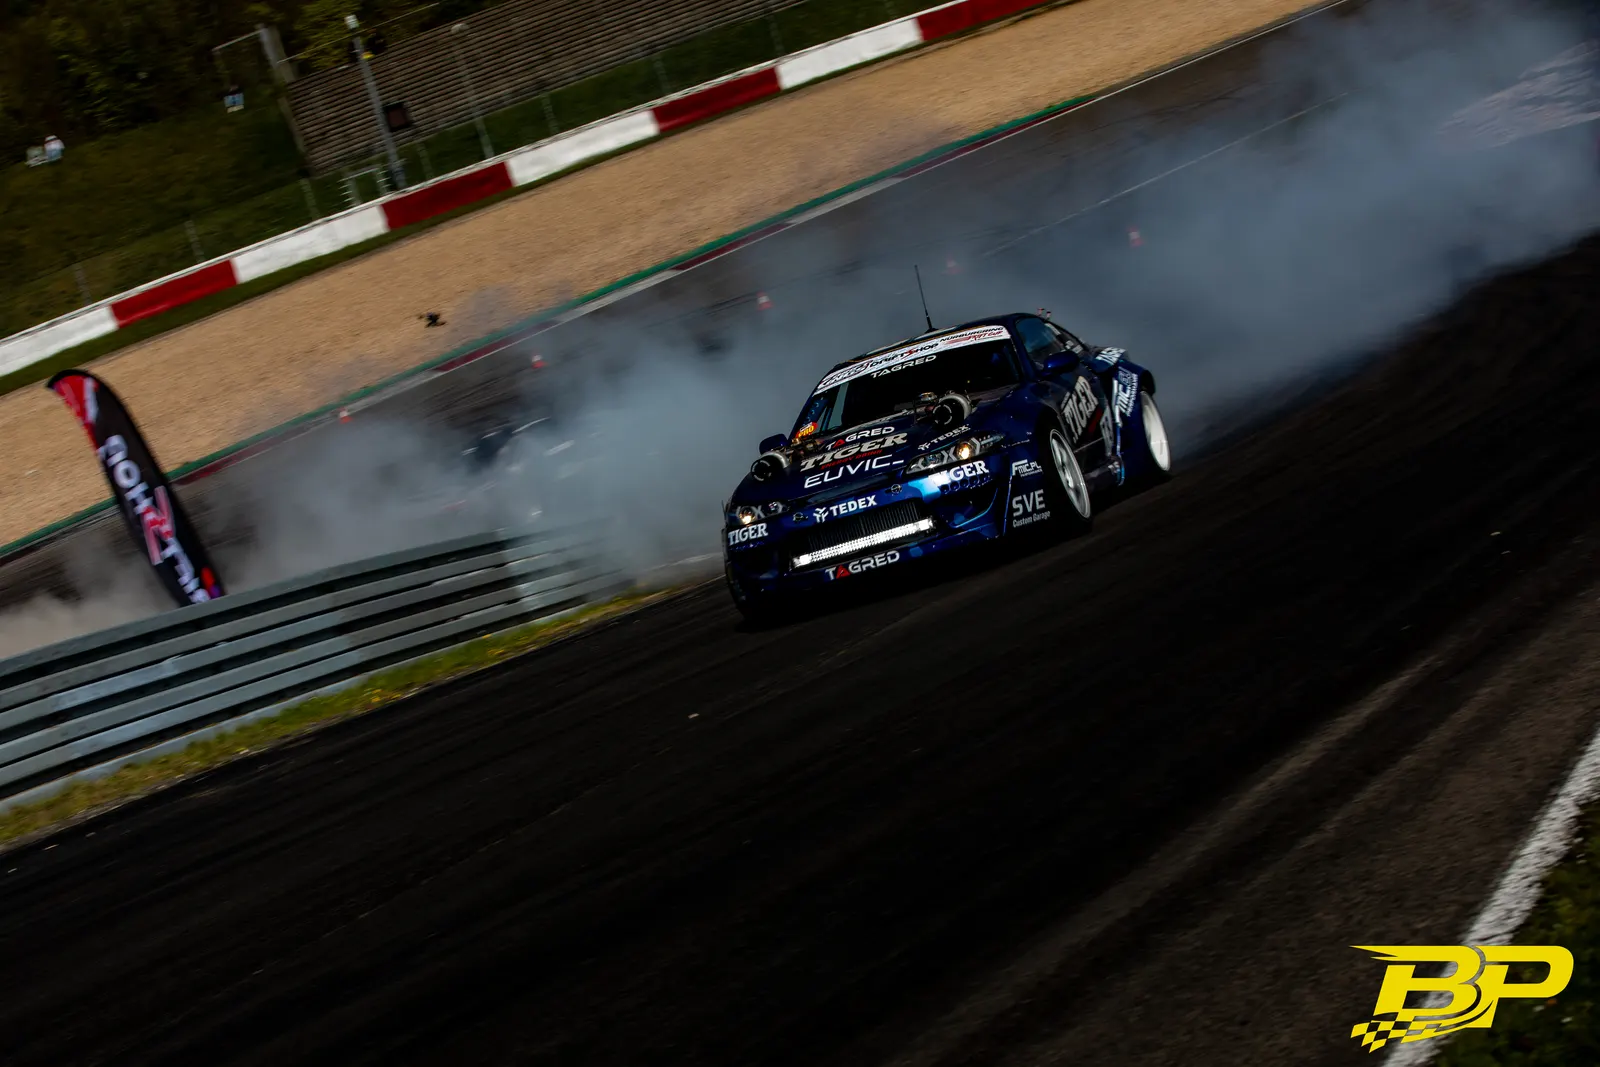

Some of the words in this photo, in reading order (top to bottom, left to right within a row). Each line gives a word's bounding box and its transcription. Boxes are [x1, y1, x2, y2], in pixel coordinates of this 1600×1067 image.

[870, 355, 937, 379] TAGRED
[1062, 375, 1099, 444] TIGER
[825, 426, 895, 450] TAGRED
[931, 424, 969, 443] TEDEX
[800, 432, 908, 472] TIGER
[829, 494, 877, 517] TEDEX
[1012, 489, 1045, 517] SVE
[1012, 515, 1033, 528] Custom
[1033, 510, 1051, 523] Garage
[727, 522, 768, 546] TIGER
[825, 550, 900, 581] TAGRED
